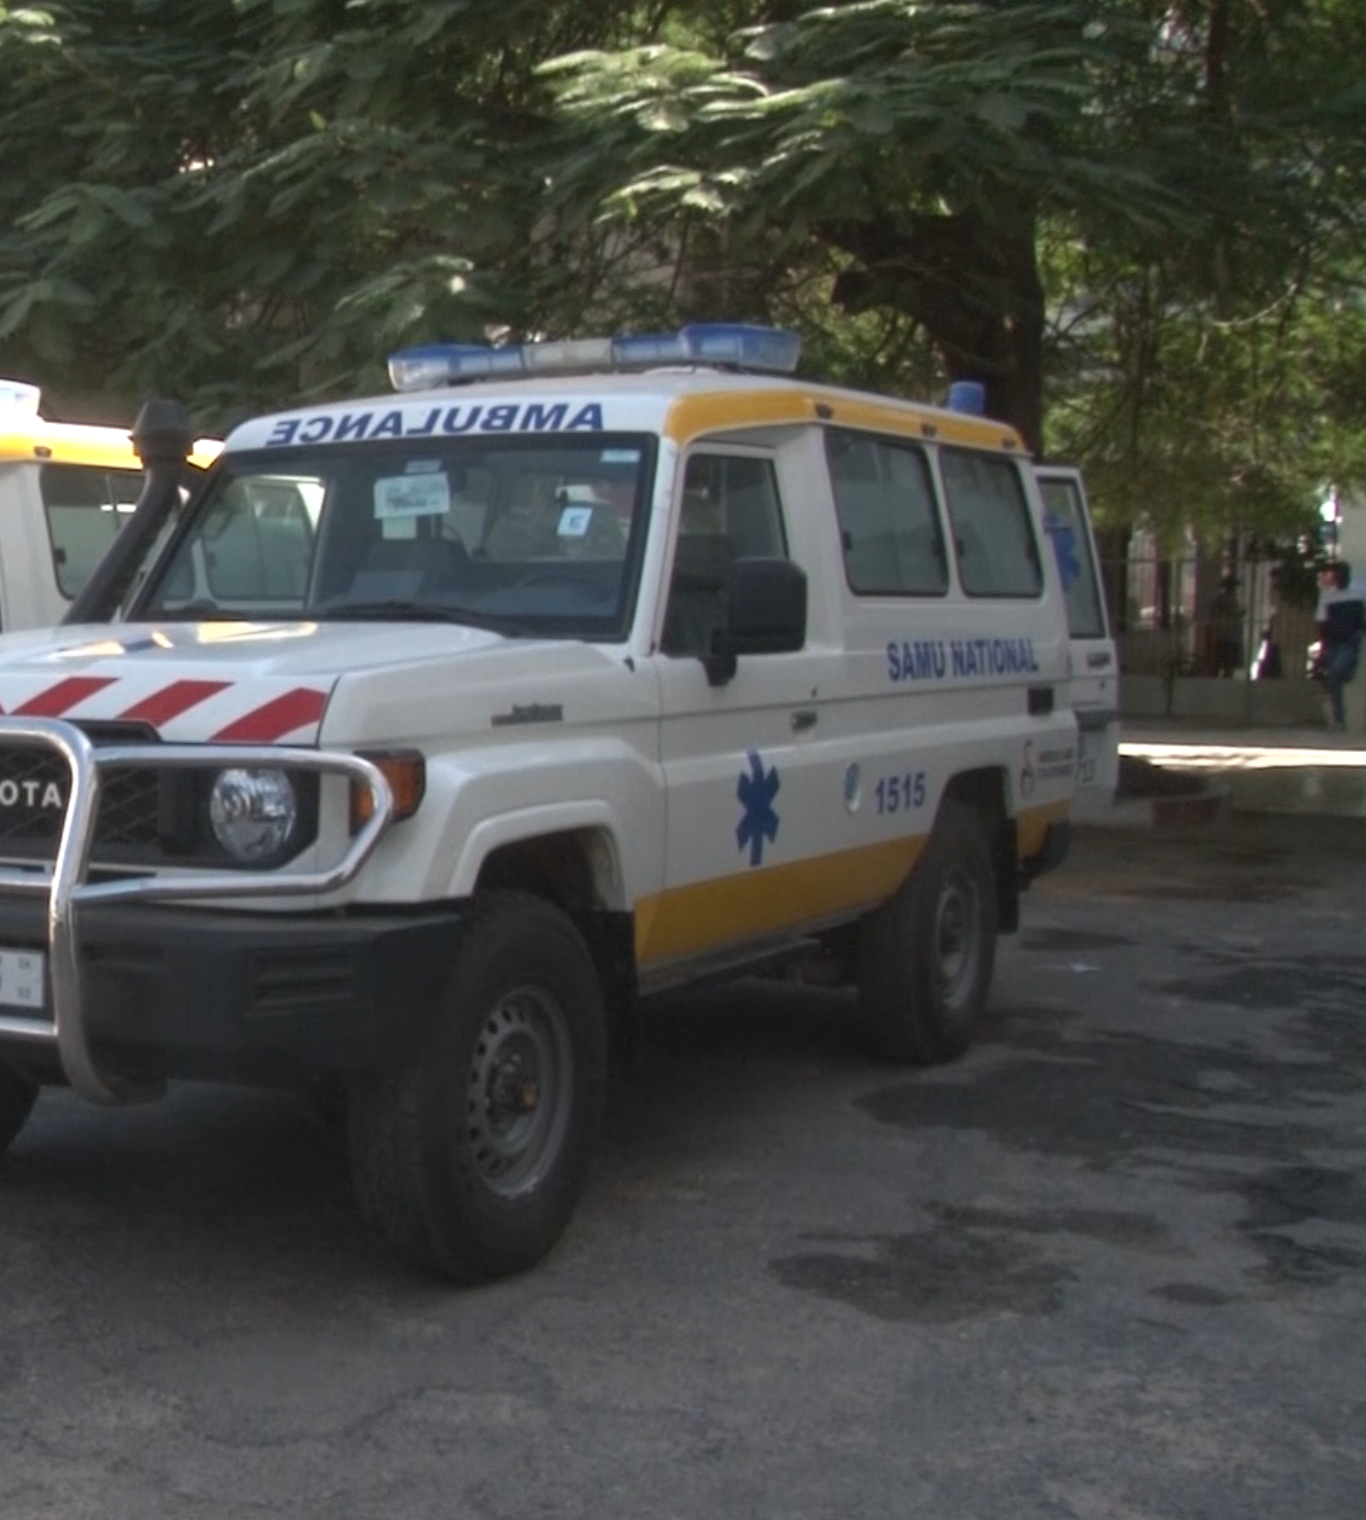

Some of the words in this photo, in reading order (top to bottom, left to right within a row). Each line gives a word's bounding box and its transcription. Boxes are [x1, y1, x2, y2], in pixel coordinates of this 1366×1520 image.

[886, 641, 946, 682] SAMU
[950, 638, 1039, 678] NATIONAL
[875, 771, 926, 816] 1515
